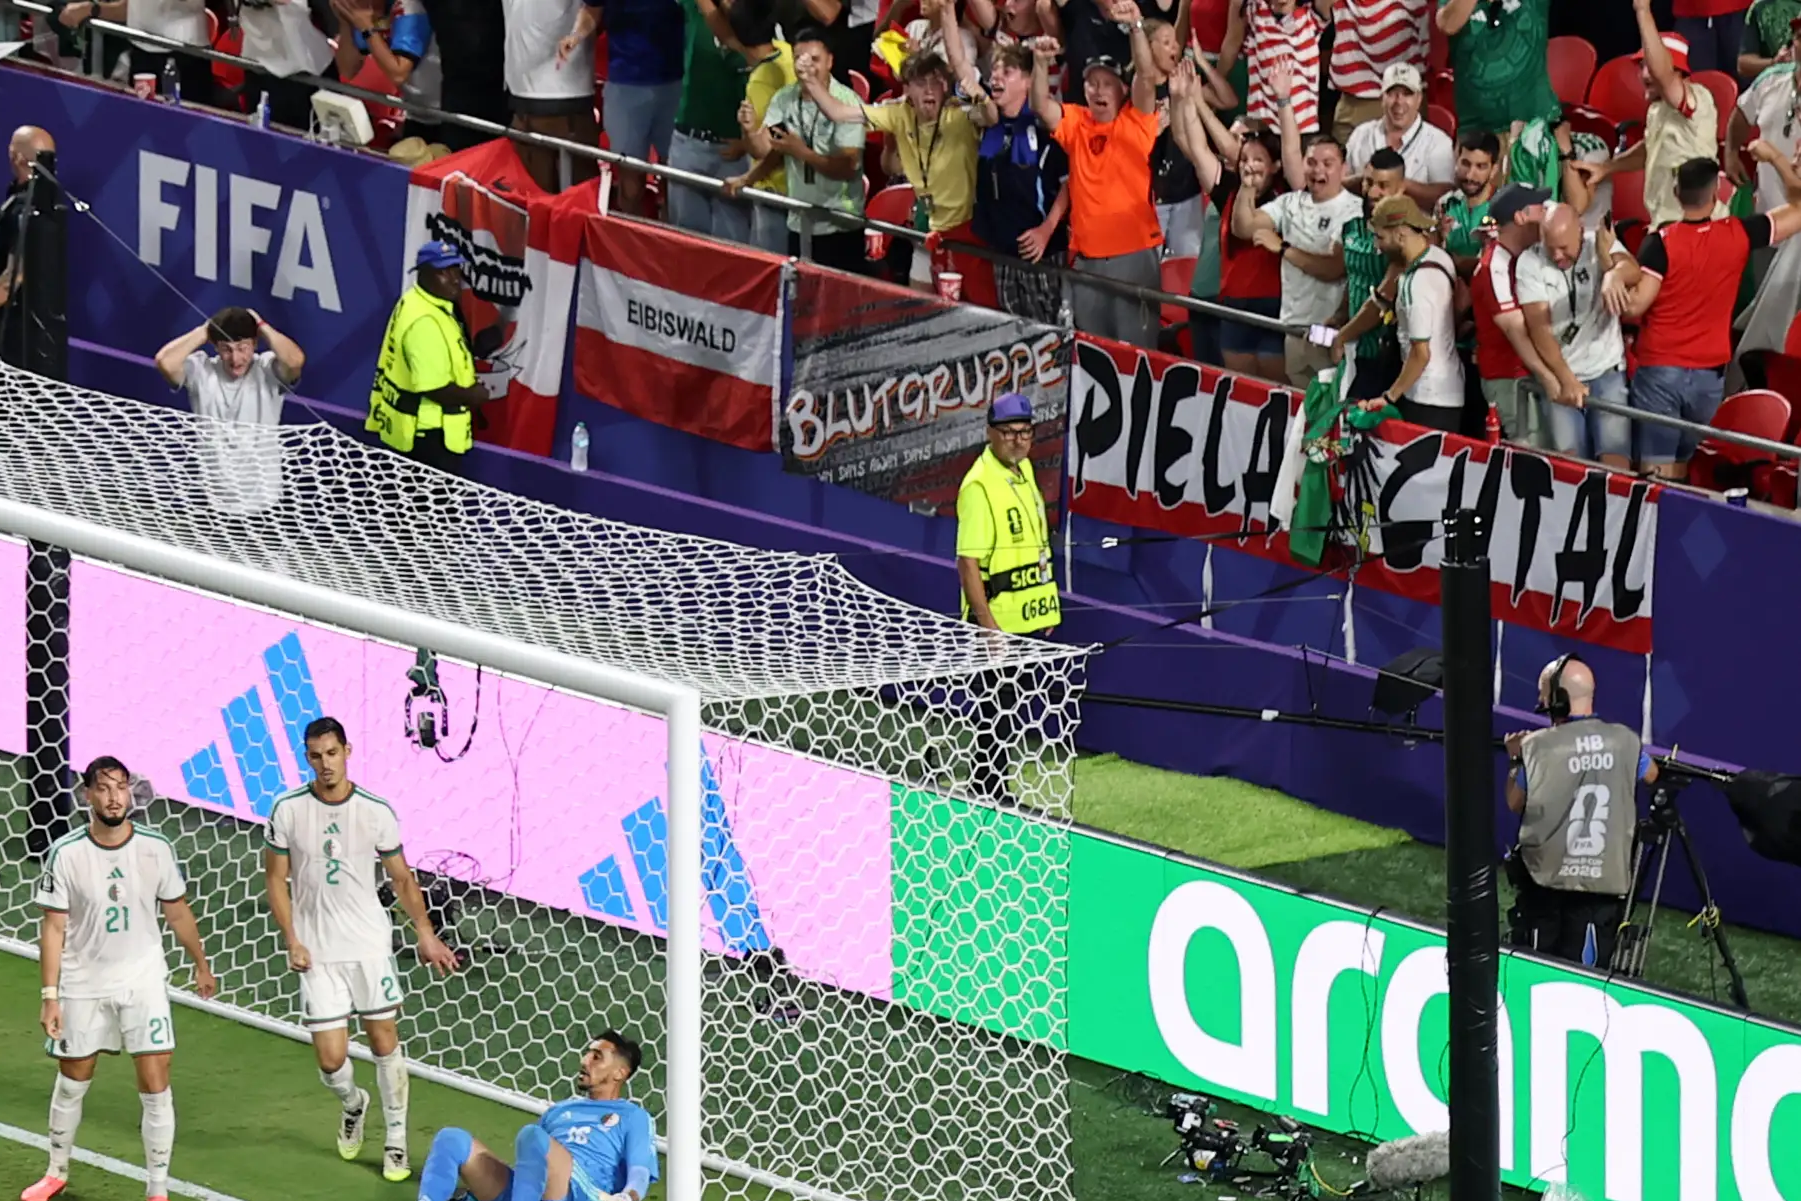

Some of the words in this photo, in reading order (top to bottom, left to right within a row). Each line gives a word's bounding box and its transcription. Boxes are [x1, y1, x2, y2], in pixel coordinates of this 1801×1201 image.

[139, 149, 342, 313] FIFA
[627, 299, 736, 353] EIBISWALD
[786, 332, 1063, 458] BLUTGRUPPE
[1575, 735, 1604, 753] HB
[325, 859, 340, 885] 2
[105, 906, 130, 933] 21
[381, 976, 398, 1001] 2
[149, 1017, 171, 1045] 21
